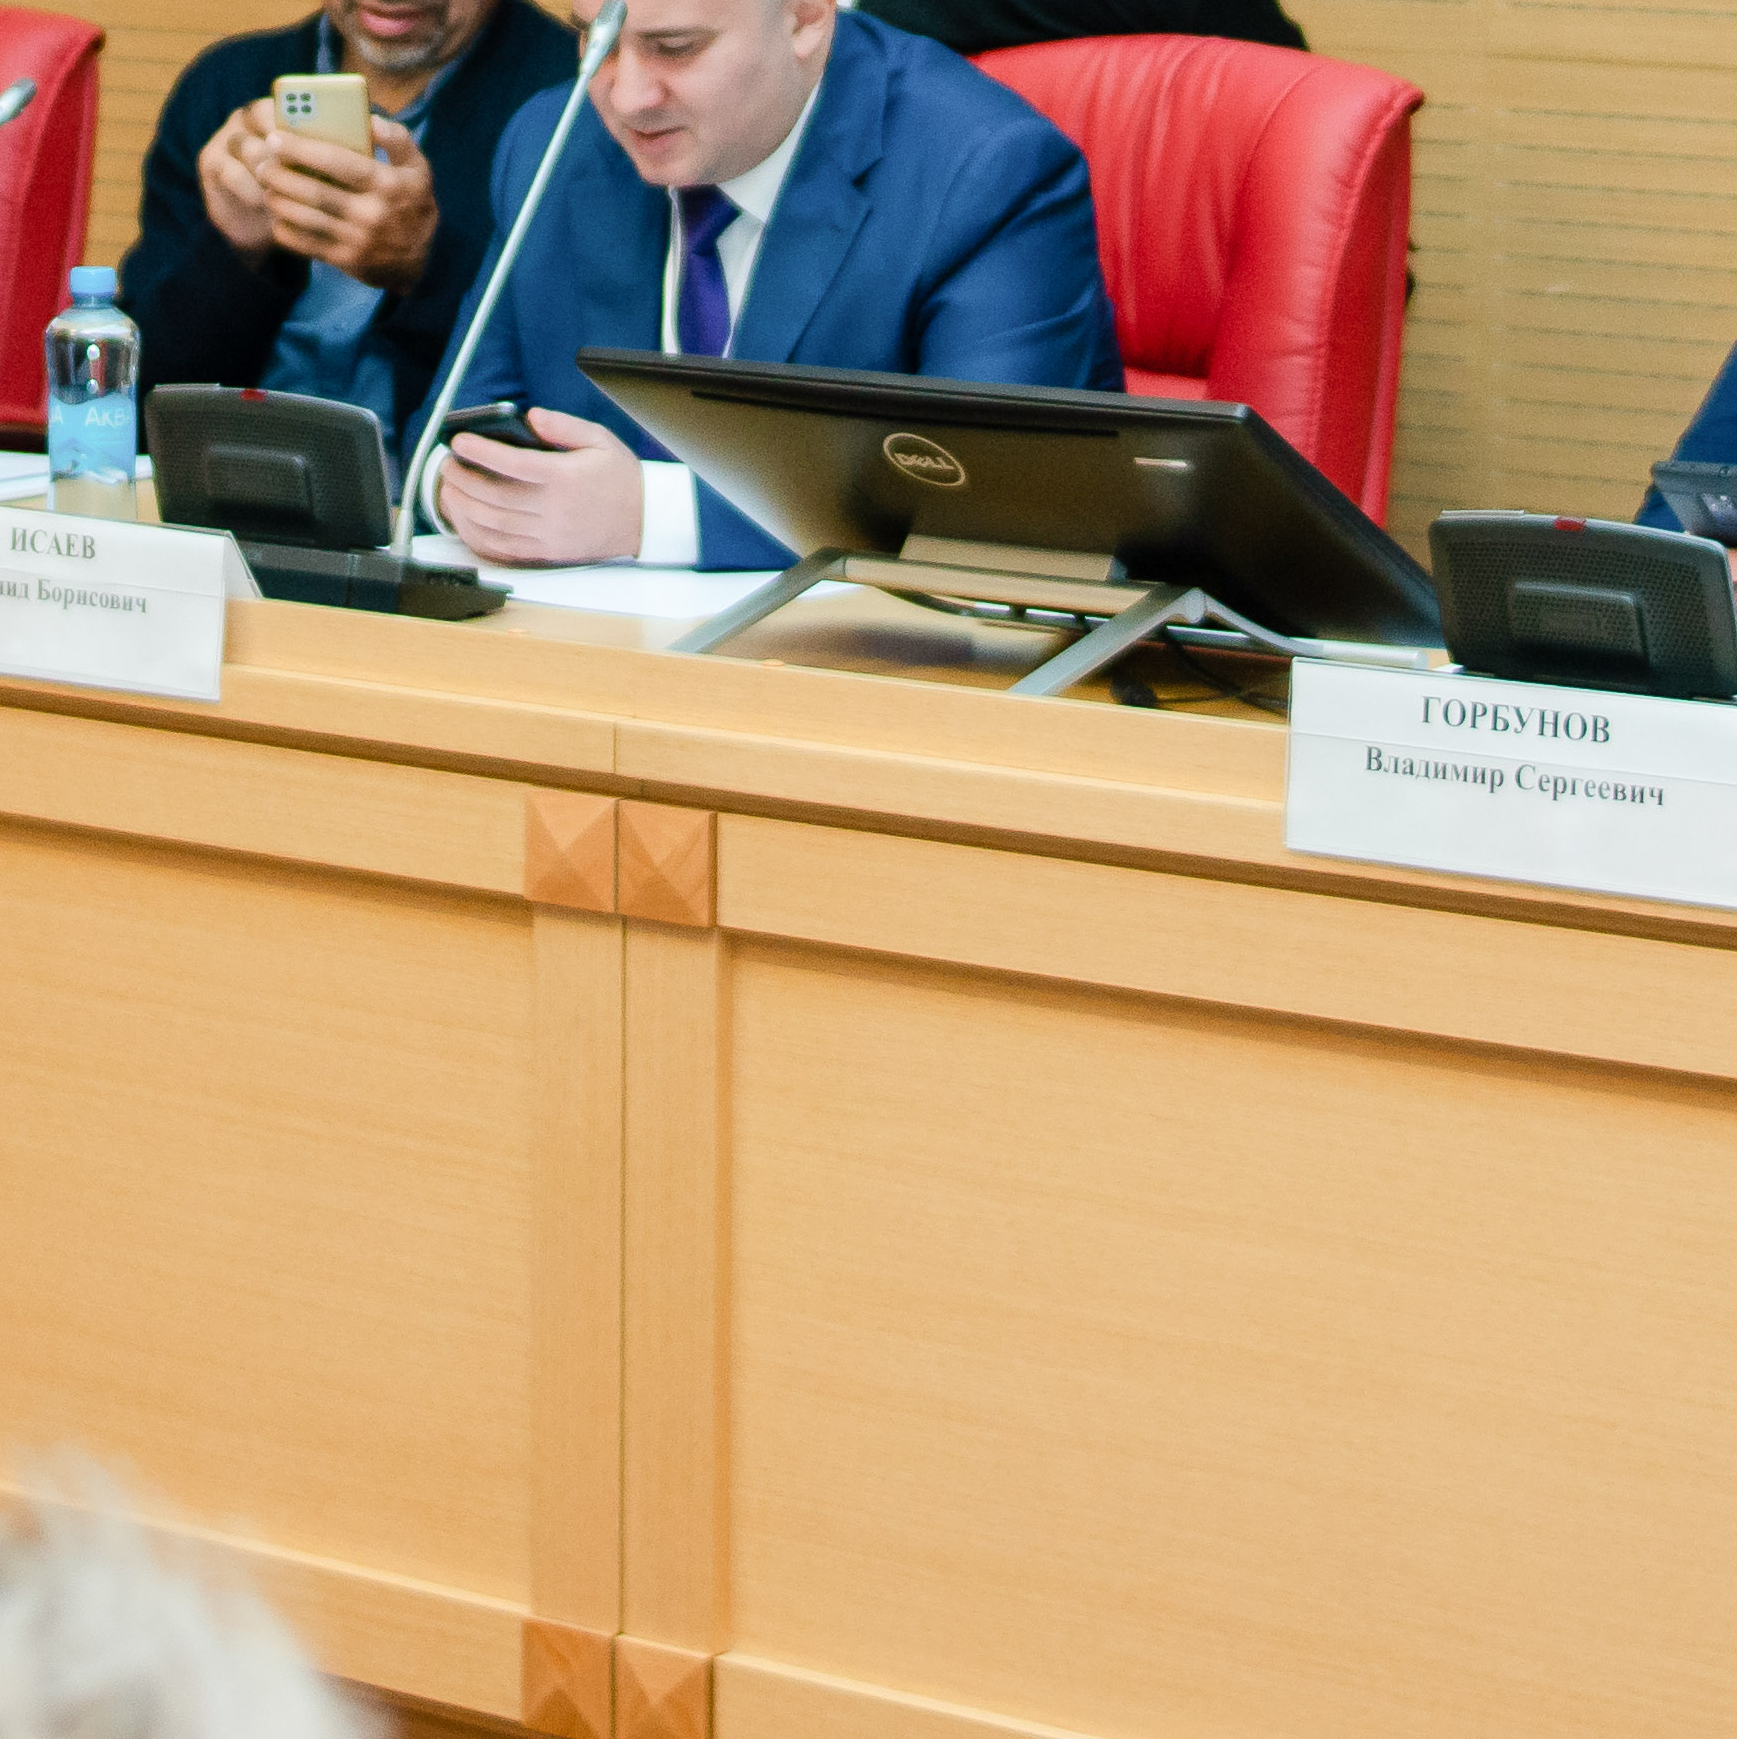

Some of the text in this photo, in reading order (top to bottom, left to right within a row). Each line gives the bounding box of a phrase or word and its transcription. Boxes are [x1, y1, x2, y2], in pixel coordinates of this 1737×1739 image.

[10, 526, 97, 560] ИСАЕВ
[37, 578, 148, 614] Борисович
[1420, 694, 1611, 744] ГОРБУНОВ
[1365, 745, 1665, 807] Владимир Сергеевич
